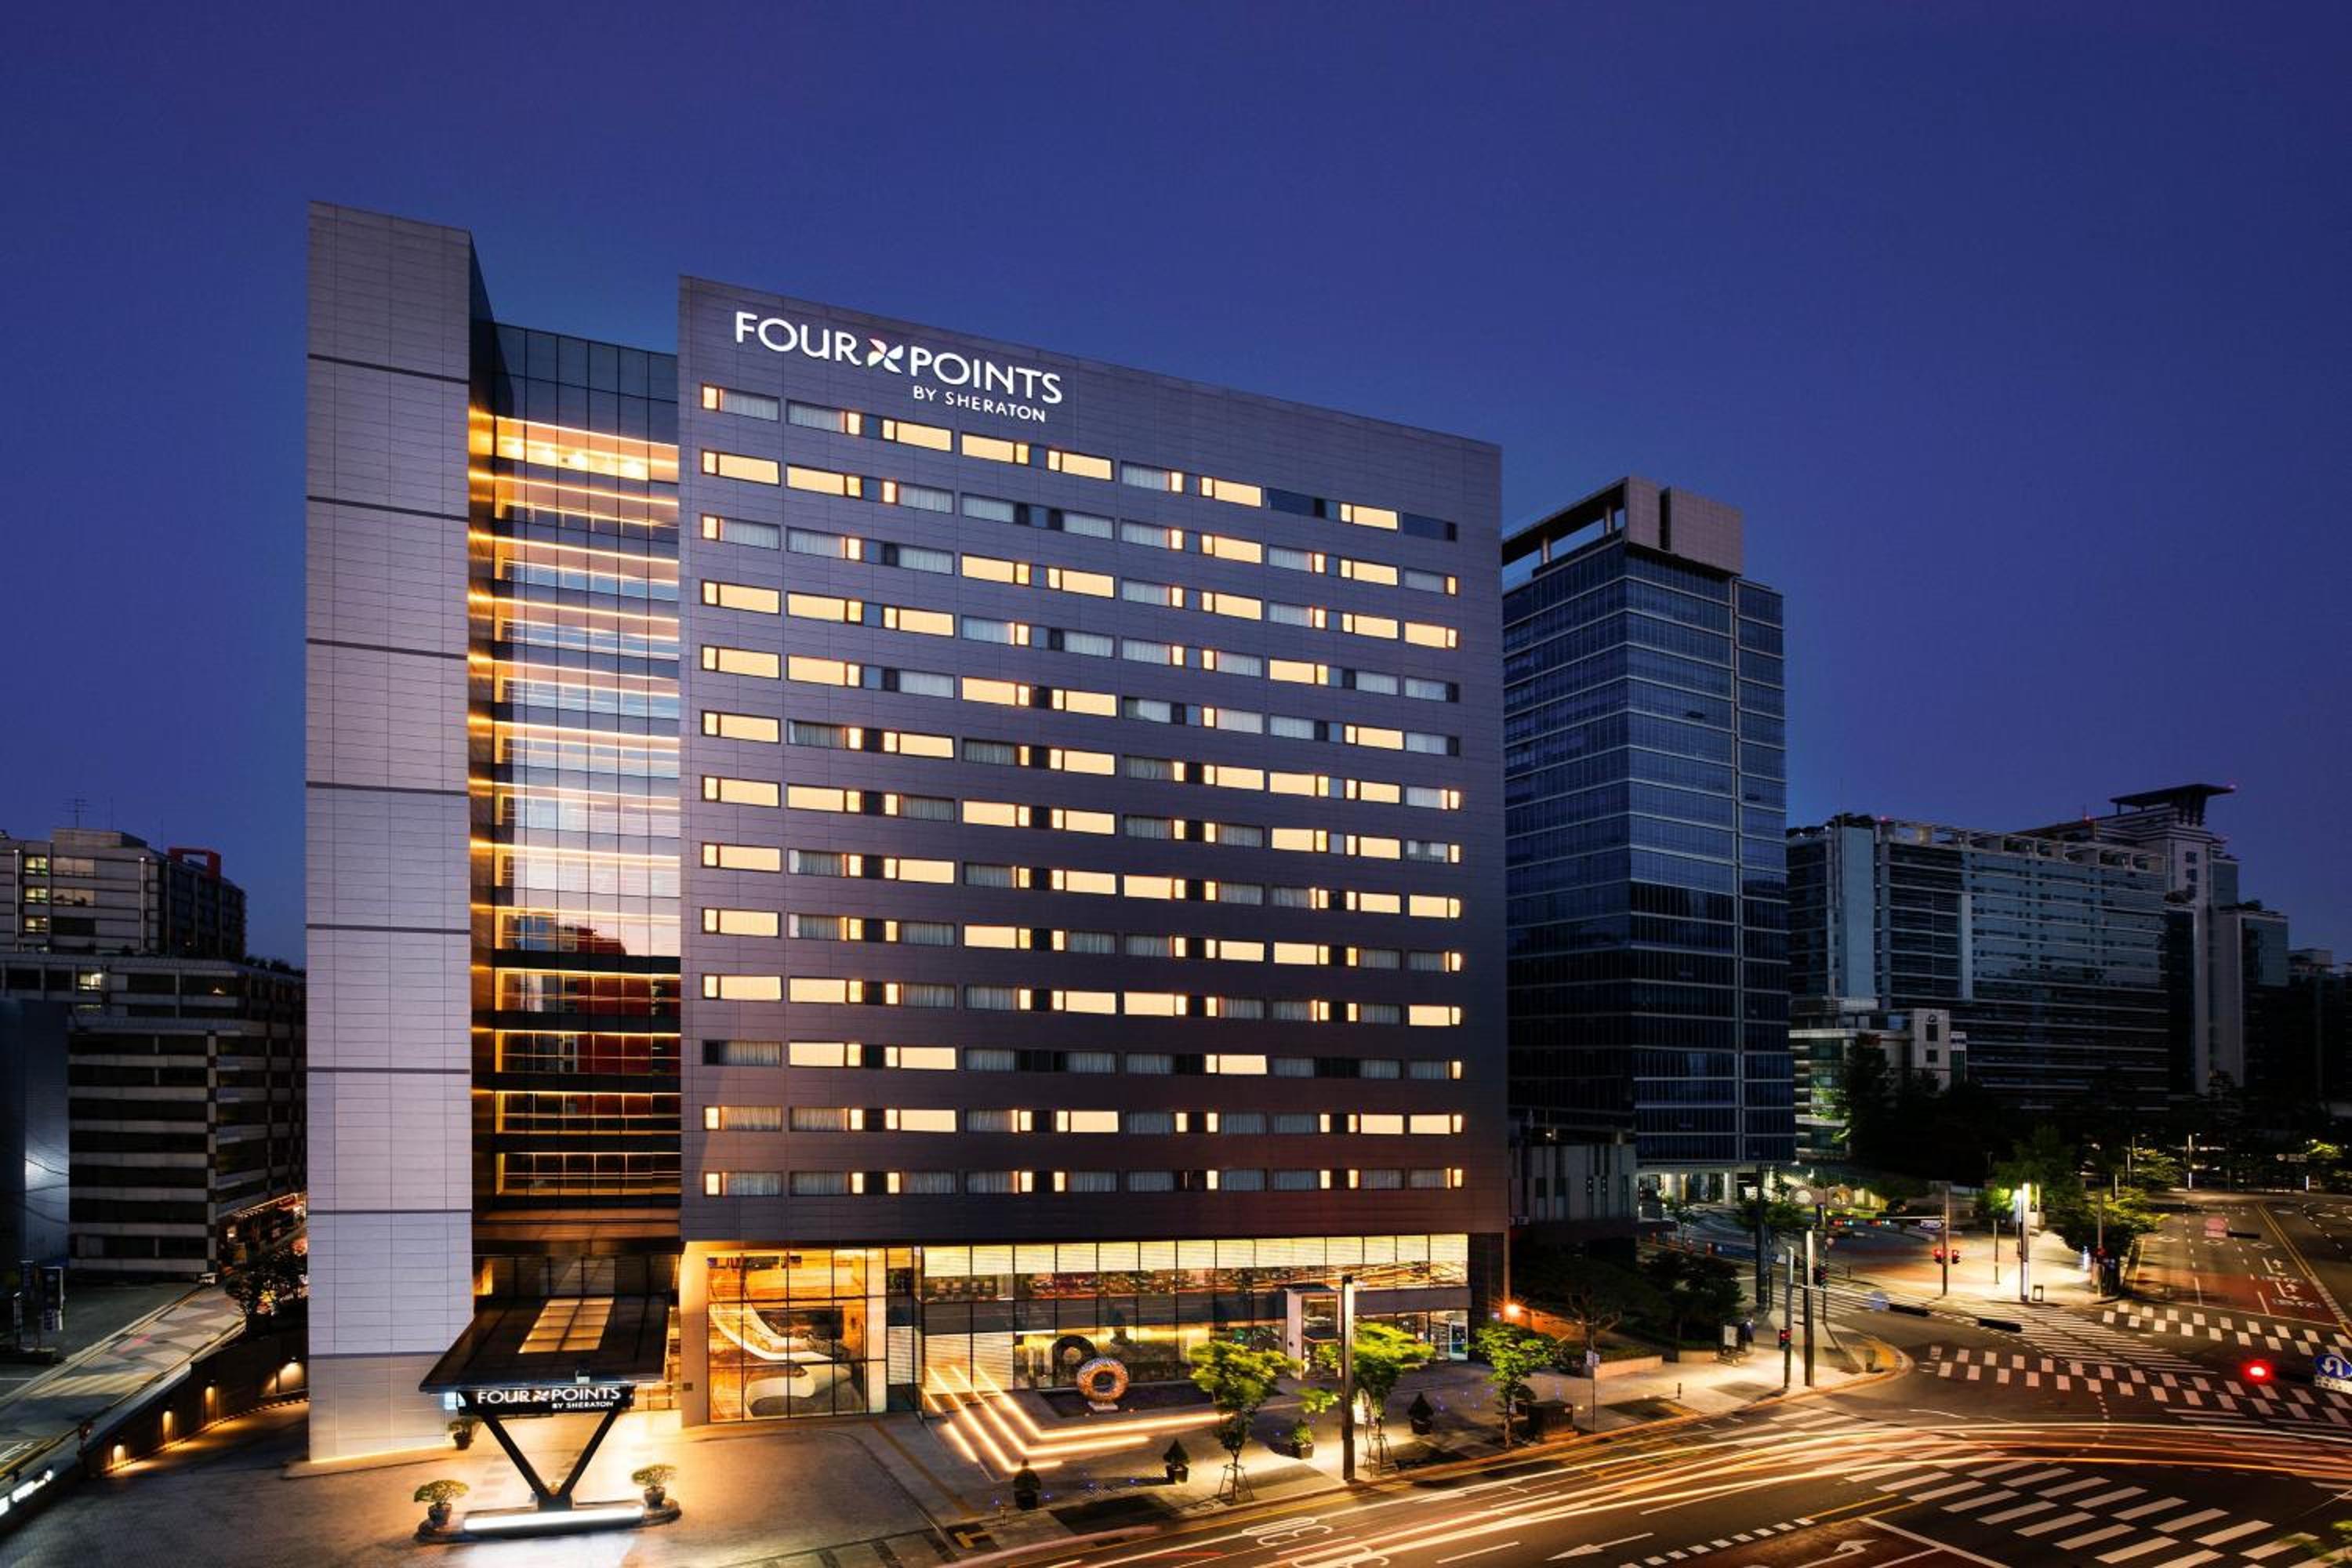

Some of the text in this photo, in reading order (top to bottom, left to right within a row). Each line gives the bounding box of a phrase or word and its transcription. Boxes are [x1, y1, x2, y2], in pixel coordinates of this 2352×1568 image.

[735, 311, 1062, 404] FOUR POINTS
[913, 385, 1045, 423] BY SHERATON
[477, 1387, 621, 1404] FOUR POINTS
[565, 1400, 614, 1410] SHERATON
